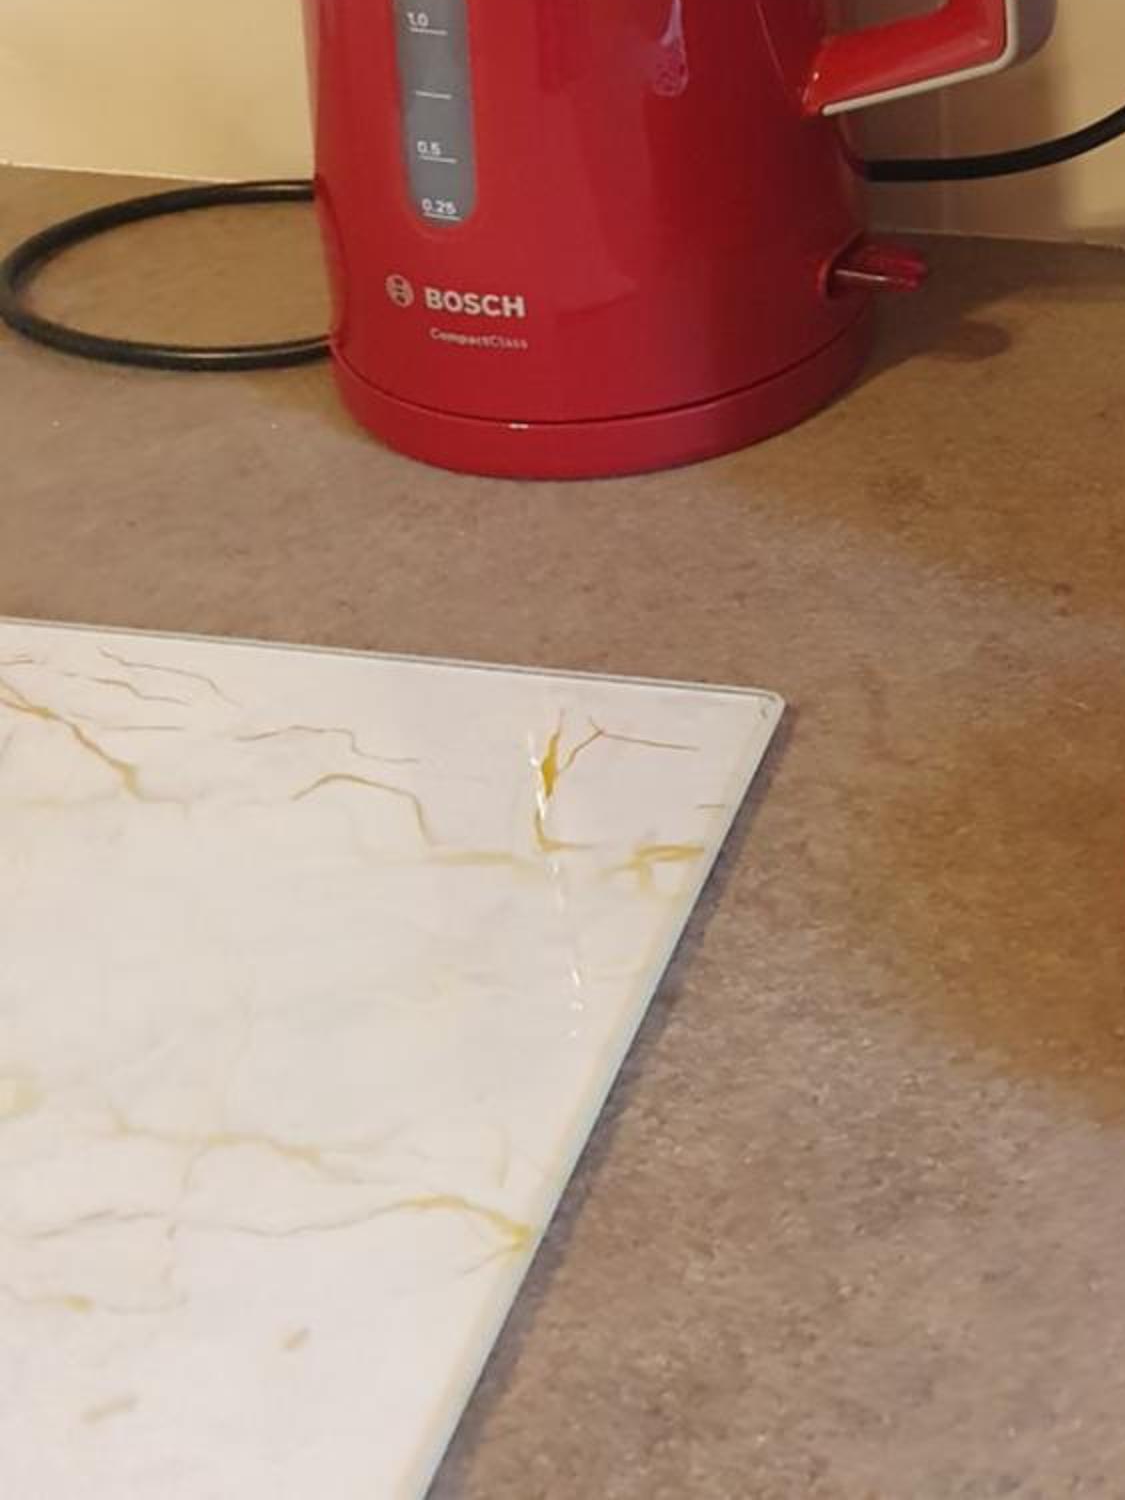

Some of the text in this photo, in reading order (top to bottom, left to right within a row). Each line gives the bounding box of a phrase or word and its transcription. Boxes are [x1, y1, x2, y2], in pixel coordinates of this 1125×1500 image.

[407, 11, 430, 27] 1.0
[417, 140, 441, 156] 0.5
[421, 197, 457, 215] 0.25
[424, 286, 526, 318] BOSCH
